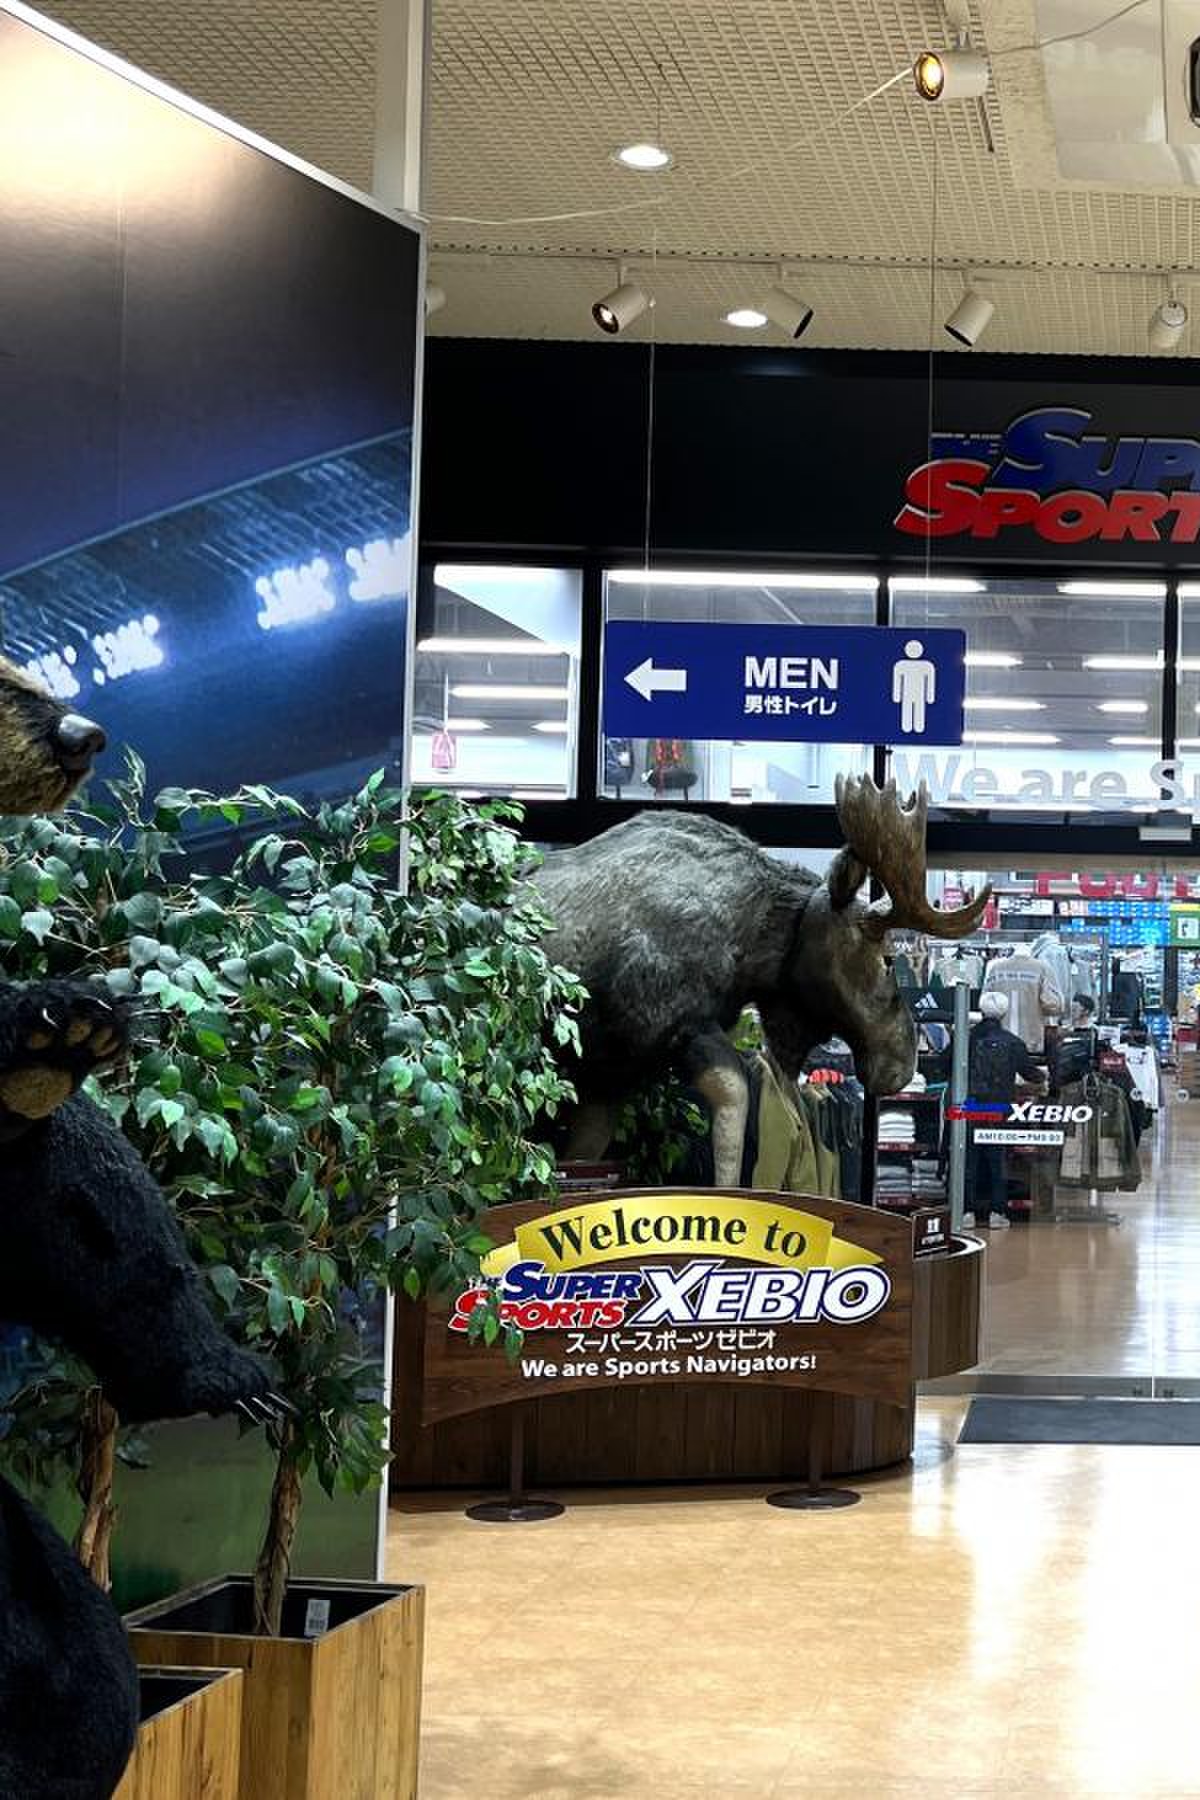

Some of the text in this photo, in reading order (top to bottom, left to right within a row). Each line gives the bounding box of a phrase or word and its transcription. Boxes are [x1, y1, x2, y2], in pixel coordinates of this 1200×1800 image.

[744, 656, 838, 689] MEN
[743, 694, 837, 715] 男性トイレ
[893, 753, 1001, 806] We
[1017, 767, 1128, 811] are
[1007, 1101, 1093, 1123] XEBIO
[539, 1207, 807, 1262] Welcome to
[502, 1261, 643, 1301] SUPER
[626, 1259, 891, 1327] XEBIO
[565, 1328, 777, 1353] スーパースポーツゼビオ
[521, 1354, 817, 1379] We are Sports Navigators!
